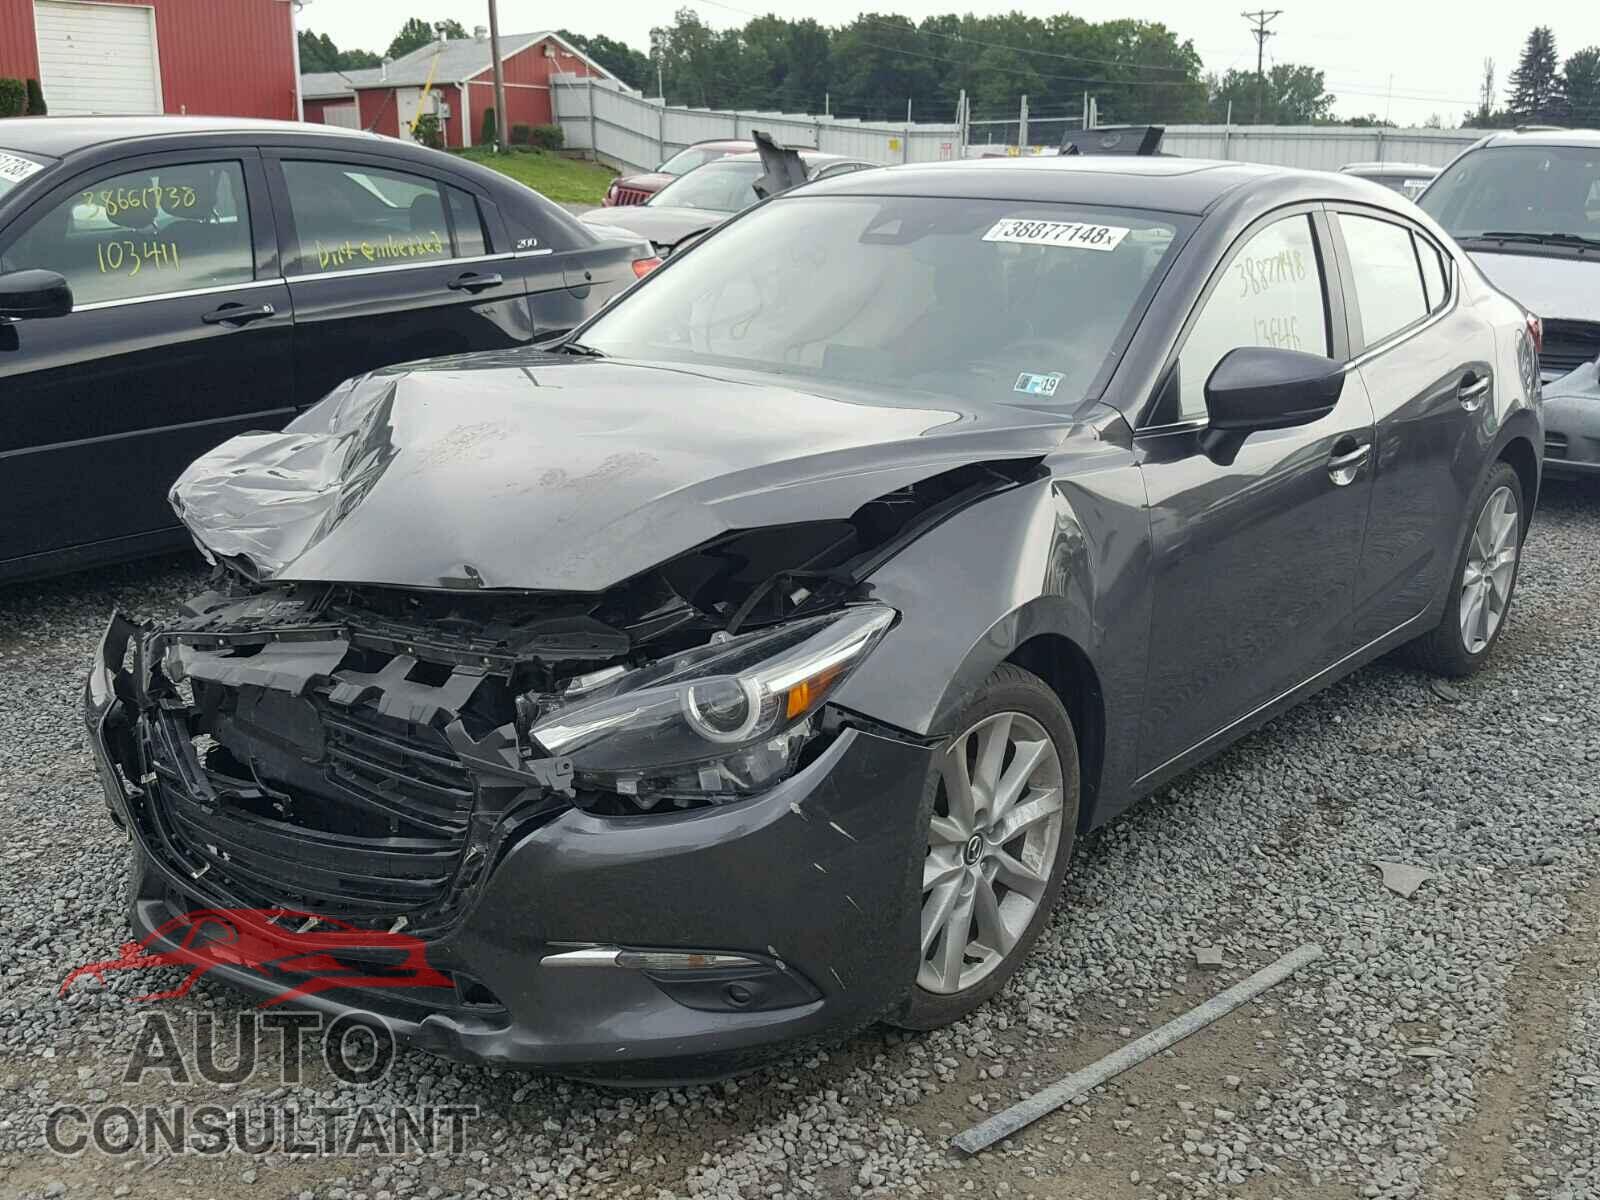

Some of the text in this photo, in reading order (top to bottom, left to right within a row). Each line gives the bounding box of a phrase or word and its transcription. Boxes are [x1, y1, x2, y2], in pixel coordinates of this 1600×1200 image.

[516, 238, 538, 249] 200
[97, 240, 181, 277] 103411
[1041, 377, 1057, 393] 19
